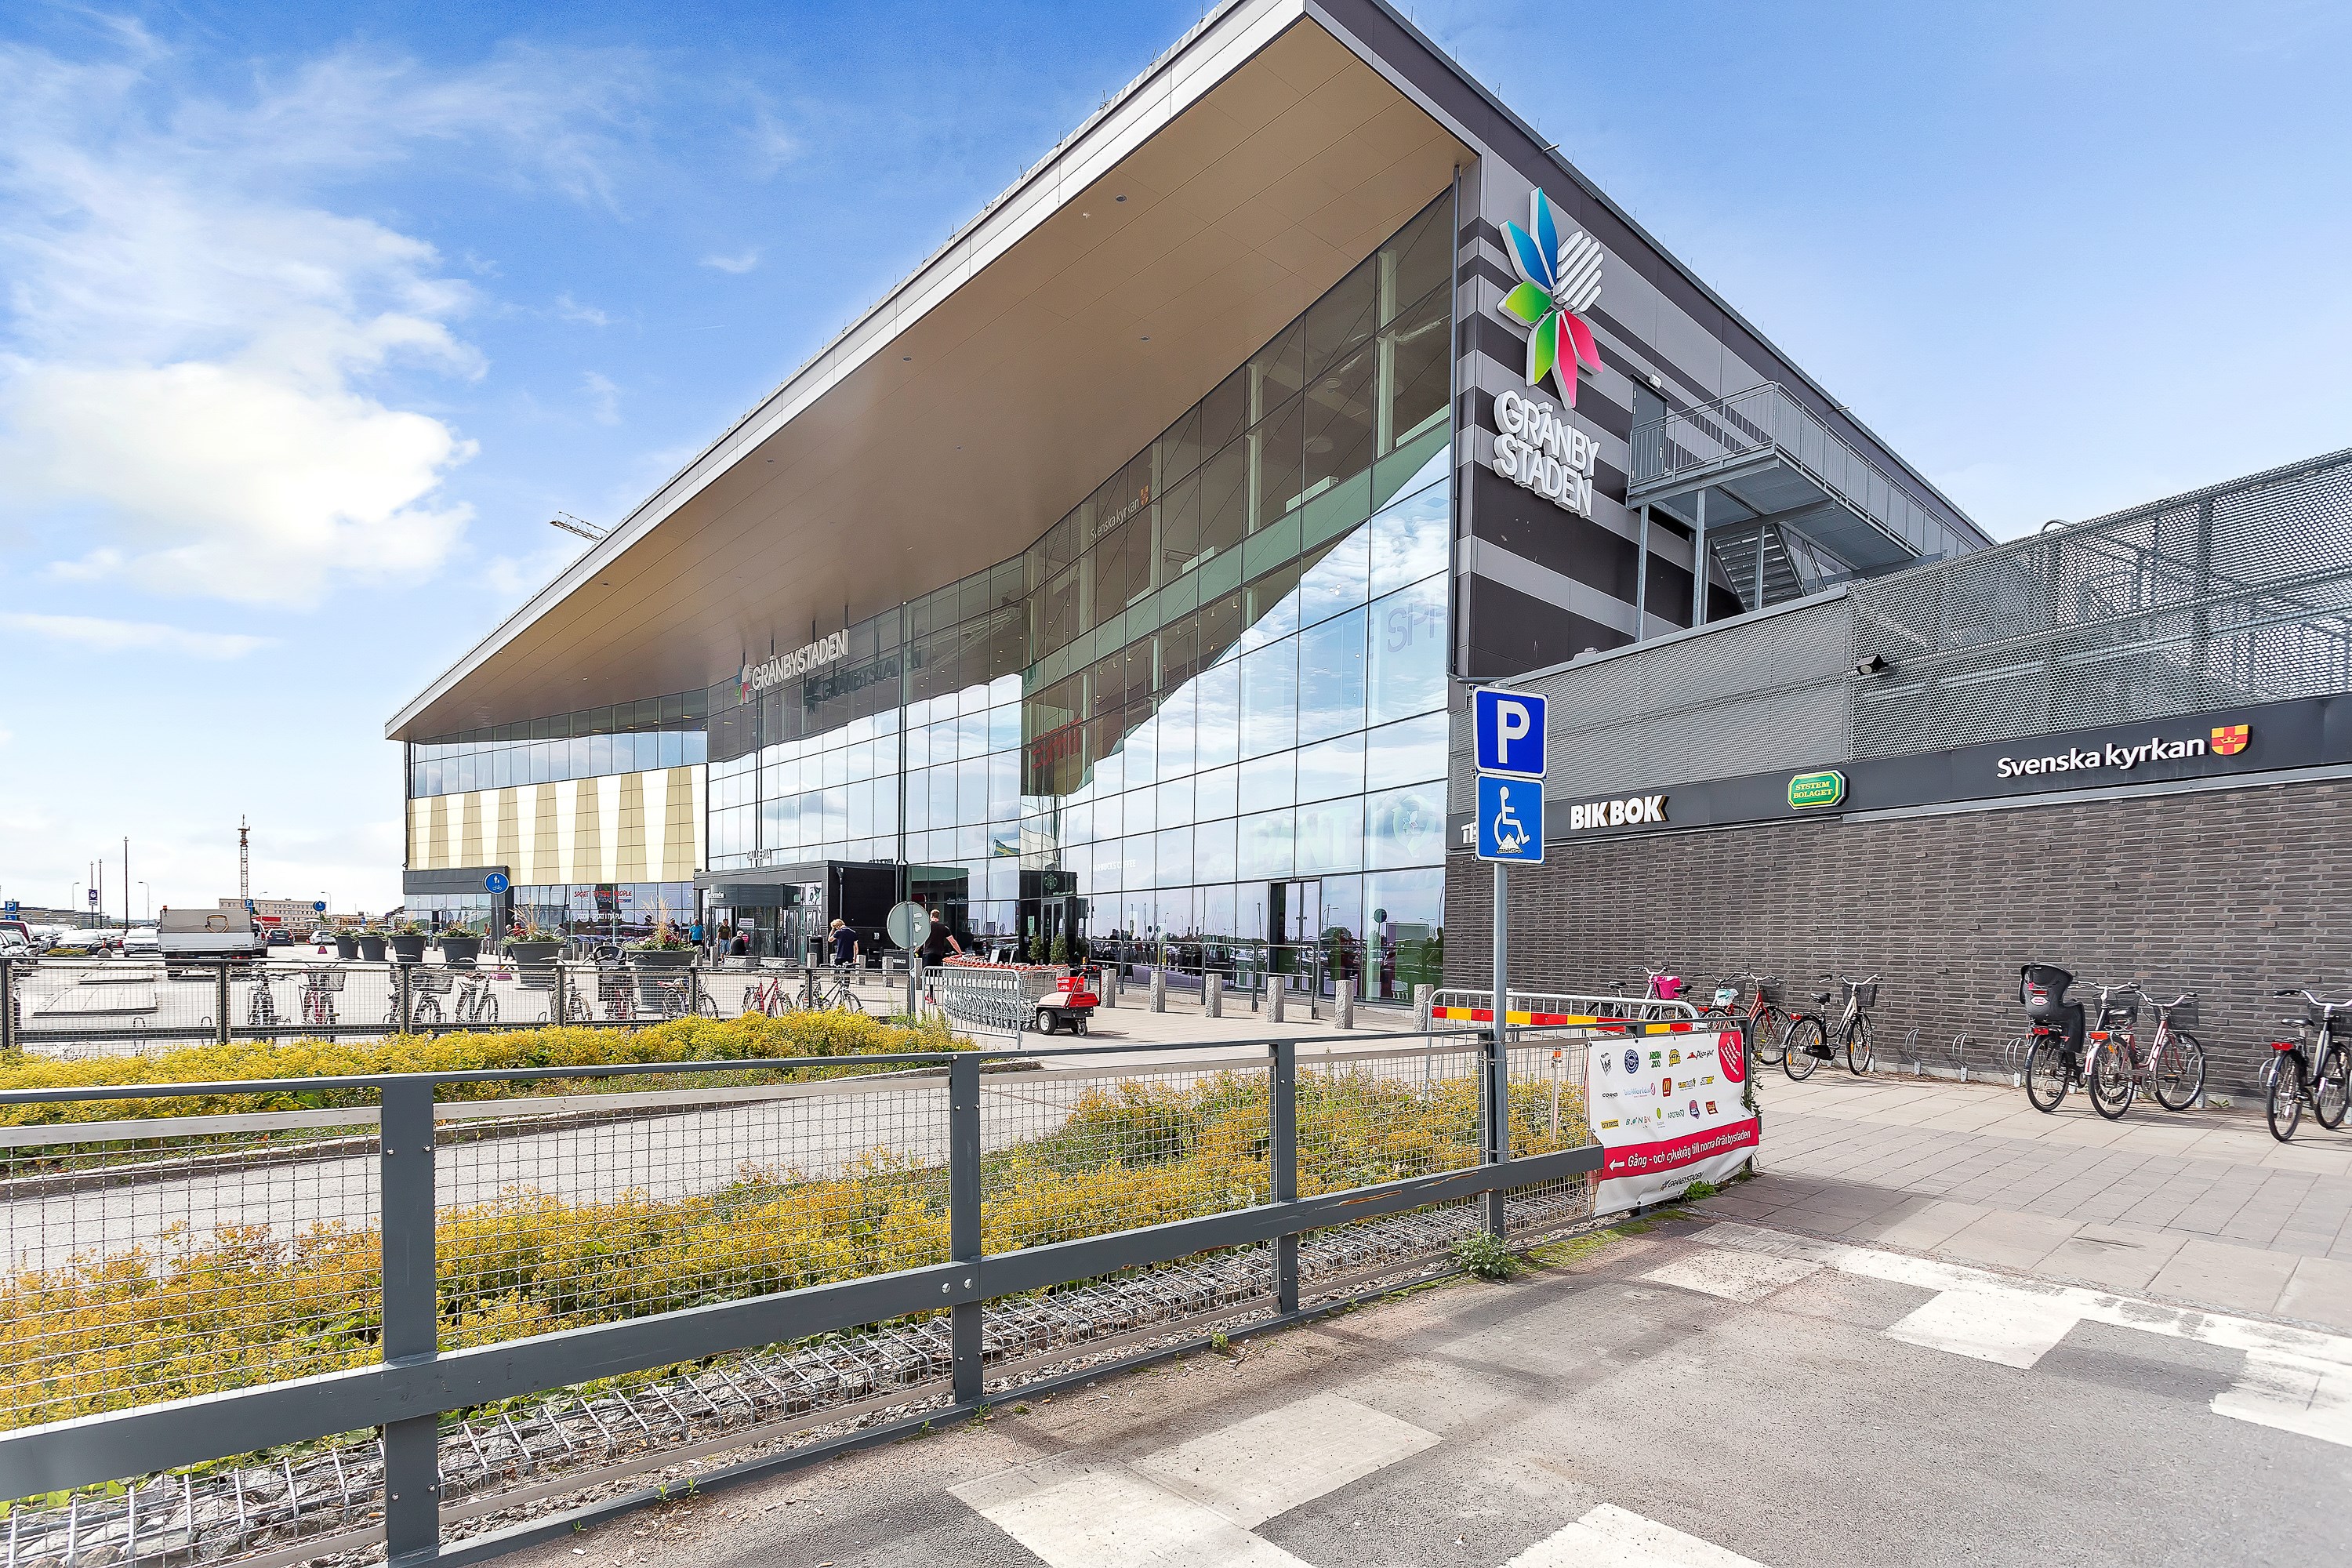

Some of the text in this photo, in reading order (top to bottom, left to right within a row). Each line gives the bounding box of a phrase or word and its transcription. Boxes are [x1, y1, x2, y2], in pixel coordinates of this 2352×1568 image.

[1494, 390, 1600, 477] GRÄNBY
[1493, 433, 1593, 518] STADEN
[751, 628, 849, 691] GRÄNBYSTADEN
[1497, 699, 1530, 764] P
[1996, 737, 2206, 779] Svenska kyrkan
[1793, 789, 1833, 798] BOLAGET
[1795, 781, 1831, 790] SYSTEM
[1628, 1153, 1647, 1167] Gång
[1653, 1152, 1665, 1164] och
[1666, 1145, 1691, 1163] cykelväg
[1700, 1140, 1715, 1152] norra
[1715, 1130, 1751, 1147] Gränbystaden
